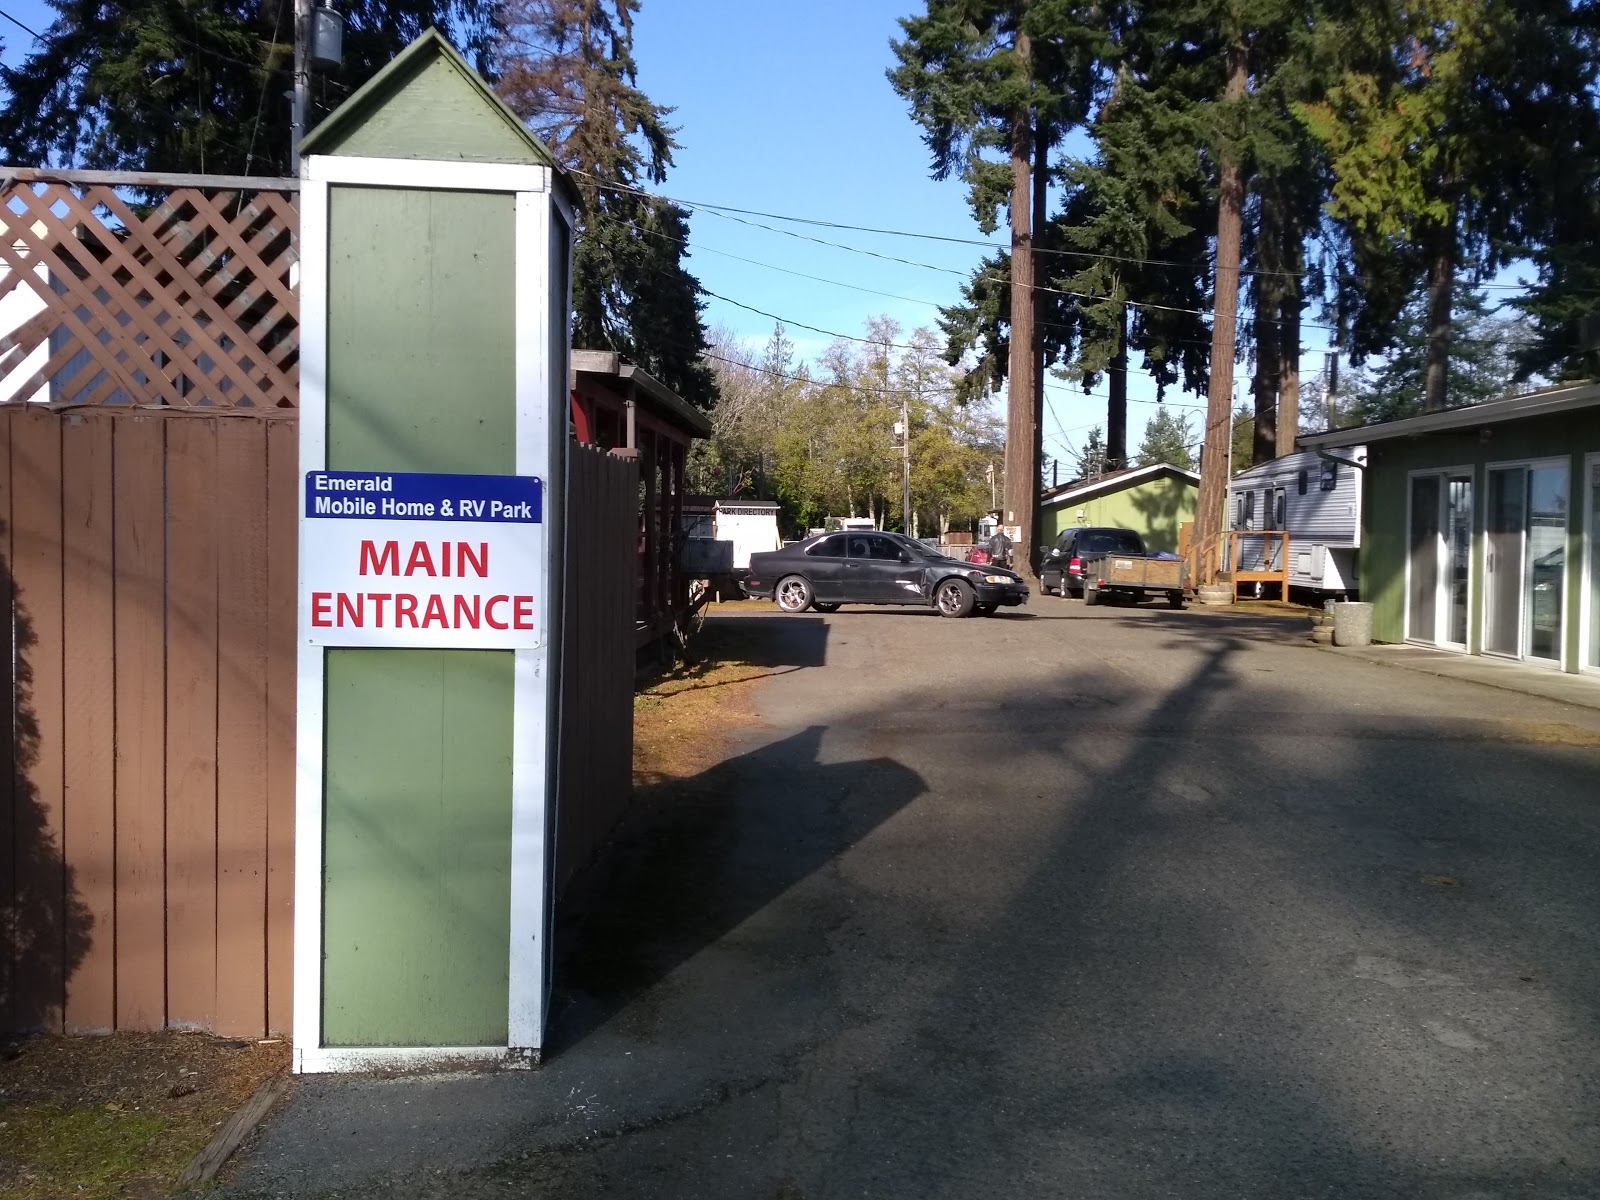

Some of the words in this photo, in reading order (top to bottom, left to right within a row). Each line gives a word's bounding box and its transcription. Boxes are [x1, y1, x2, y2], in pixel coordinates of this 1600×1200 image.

[315, 475, 393, 492] Emerald
[315, 496, 377, 515] Mobile
[381, 498, 435, 517] Home
[440, 500, 454, 517] &
[459, 500, 486, 518] RV
[490, 500, 532, 519] Park
[719, 507, 736, 515] PARK
[737, 508, 775, 516] DIRECTORY
[359, 539, 489, 578] MAIN
[311, 591, 534, 630] ENTRANCE
